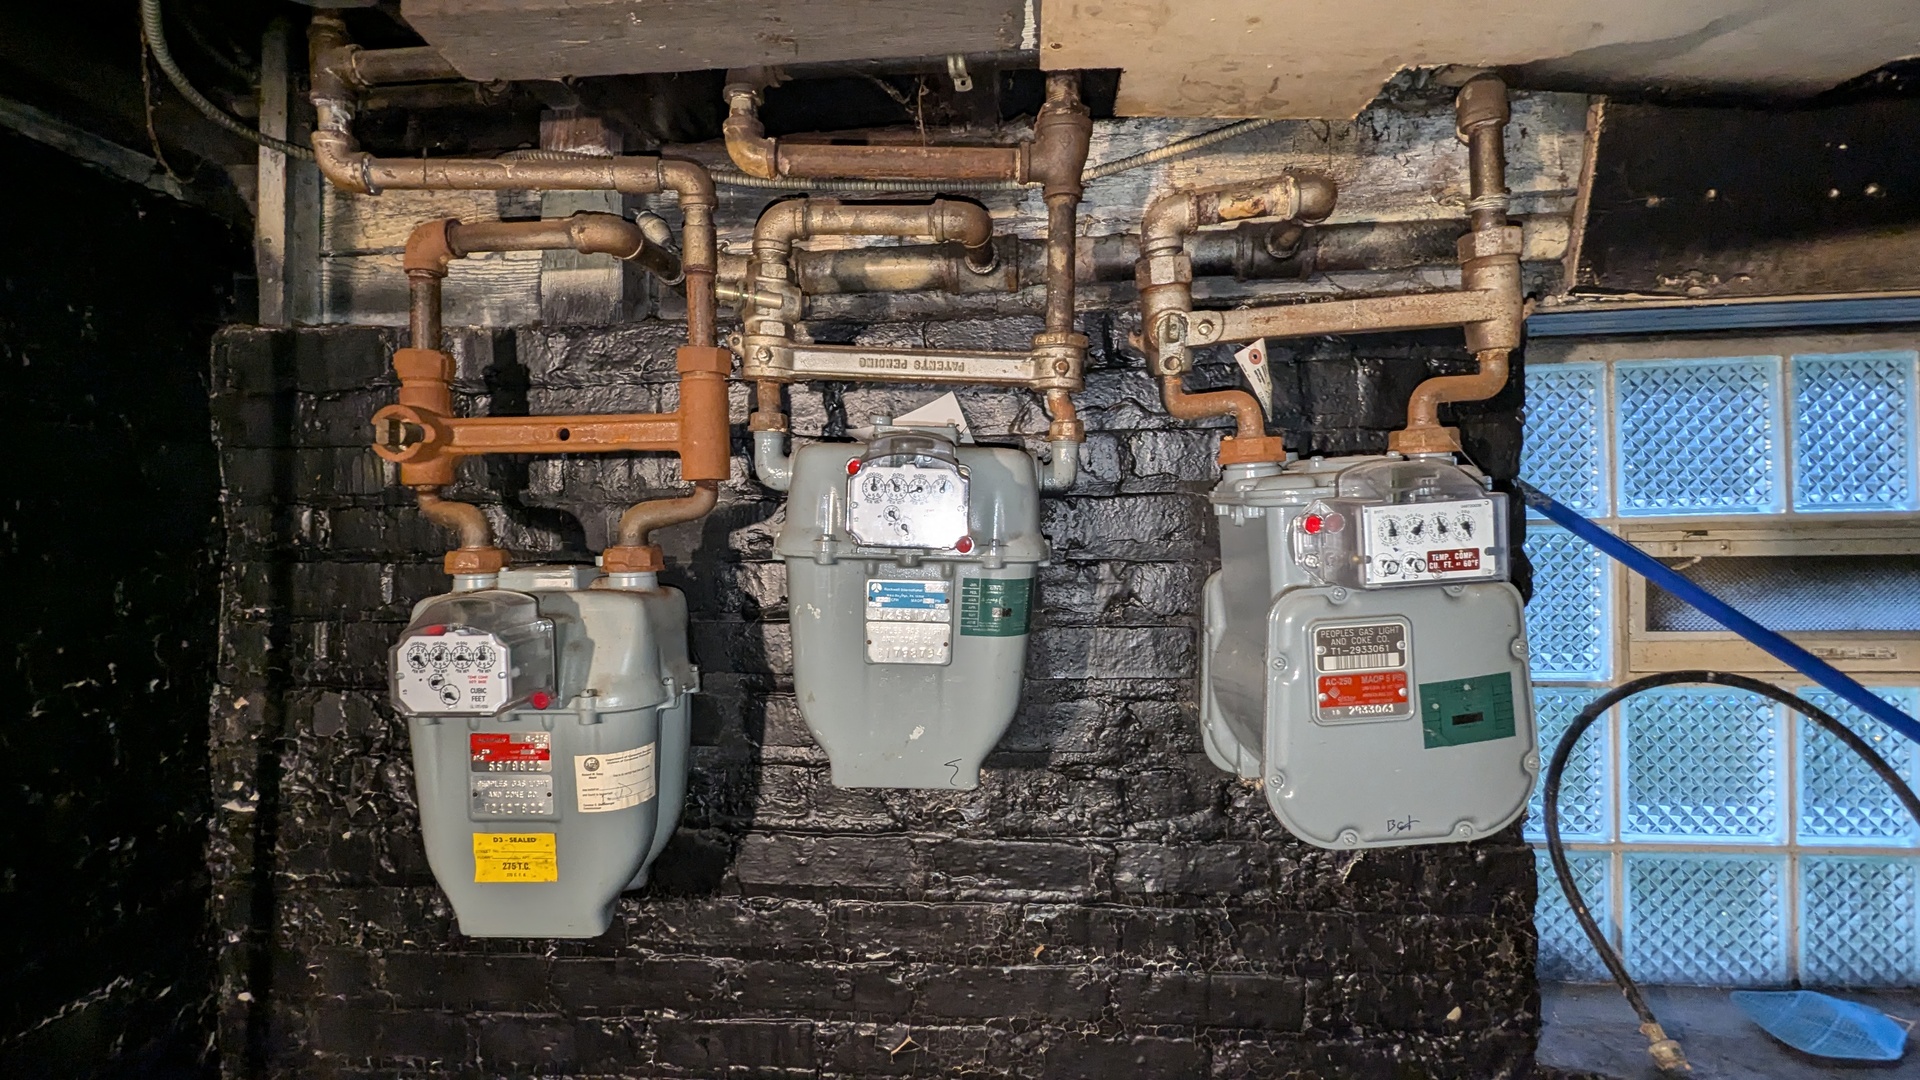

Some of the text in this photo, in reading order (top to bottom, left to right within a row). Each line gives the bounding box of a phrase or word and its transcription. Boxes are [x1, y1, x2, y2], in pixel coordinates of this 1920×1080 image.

[859, 357, 965, 372] PATENTS PENDING
[1431, 551, 1476, 561] TEMP. COMP.
[1428, 562, 1440, 570] CU.
[1321, 626, 1400, 638] PEOPLES GAS LIGHT
[1330, 635, 1391, 646] AND COKE CO.
[1330, 644, 1390, 655] T1-2933061
[1325, 677, 1353, 686] AC-250
[1361, 675, 1384, 684] MAOP
[1385, 674, 1391, 682] 5
[1348, 703, 1394, 715] 2933061
[477, 780, 550, 788] PEOPLES GAS LIGHT
[488, 790, 502, 798] AND
[505, 790, 525, 799] COKE
